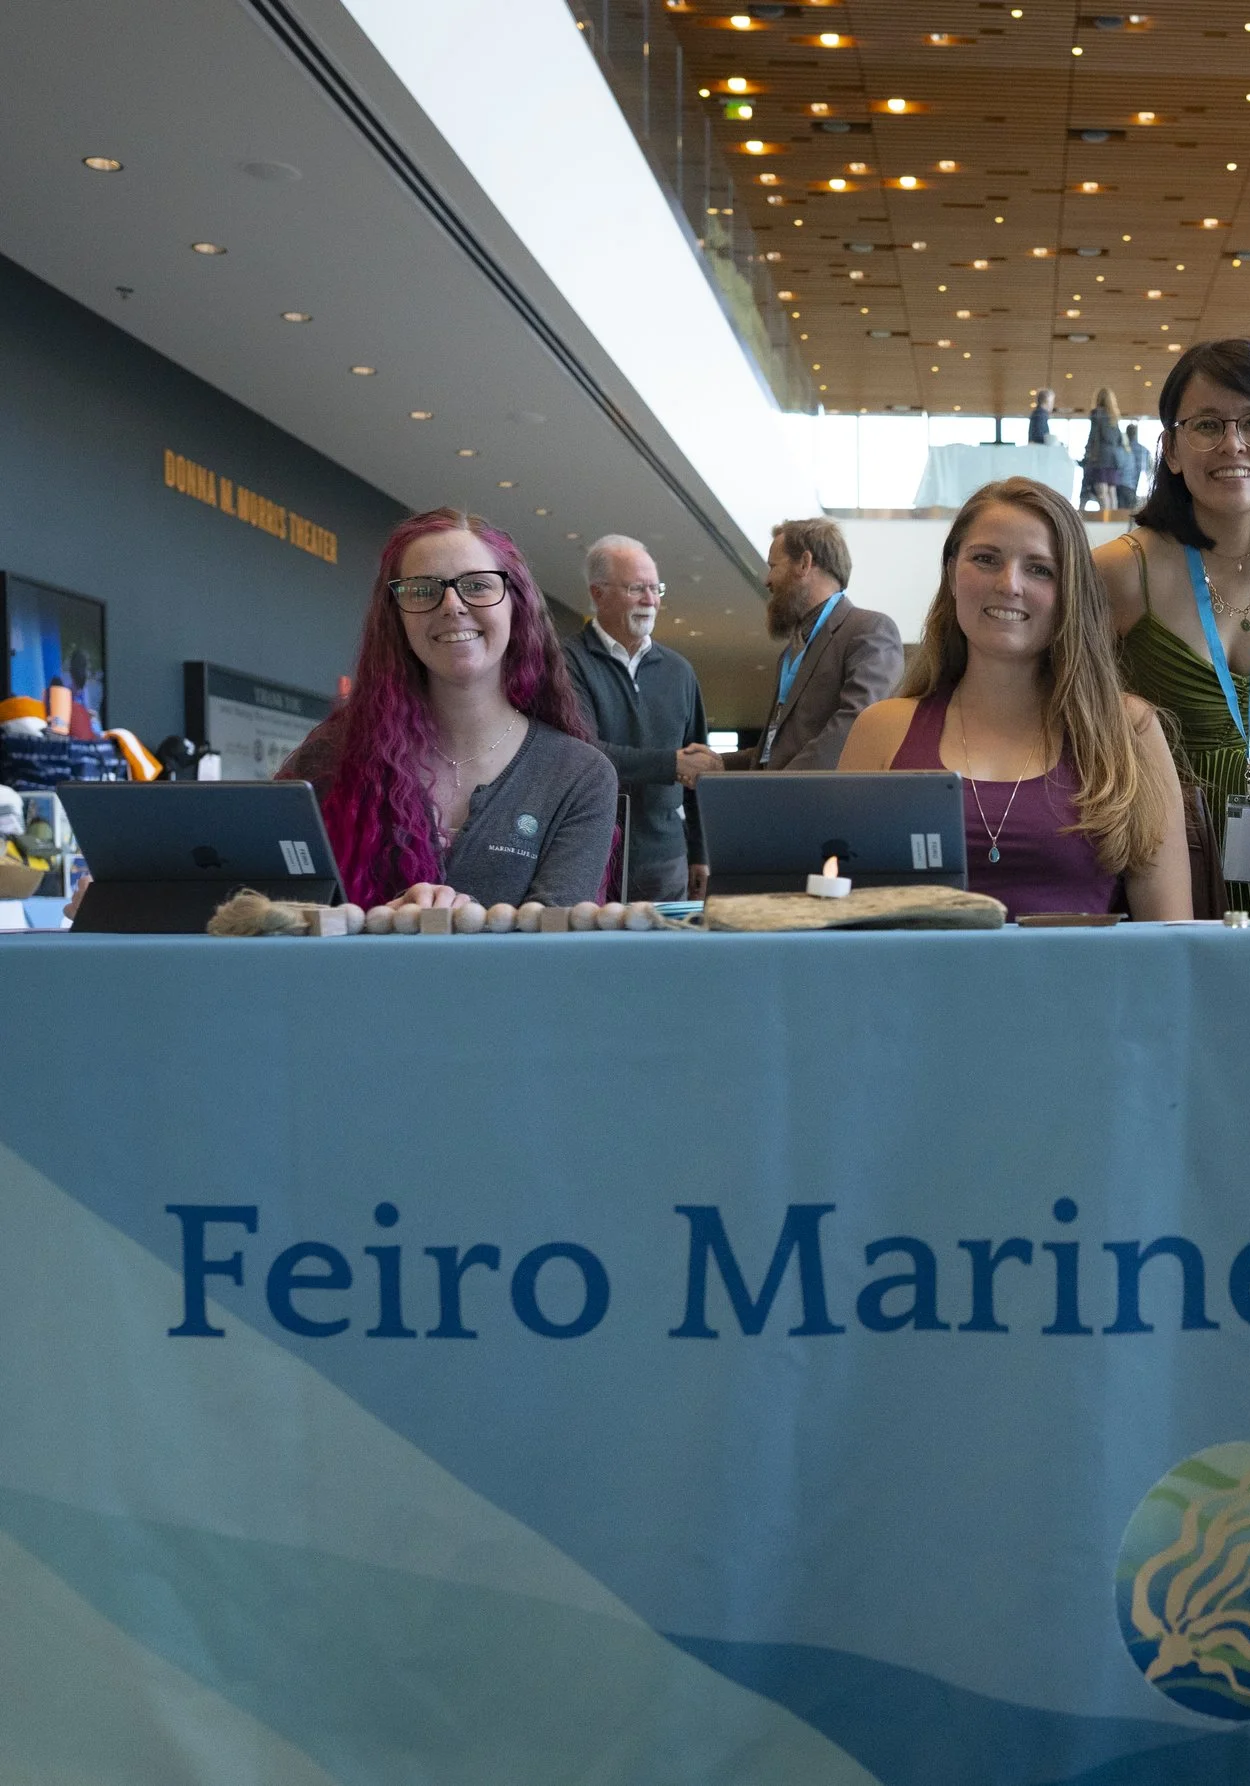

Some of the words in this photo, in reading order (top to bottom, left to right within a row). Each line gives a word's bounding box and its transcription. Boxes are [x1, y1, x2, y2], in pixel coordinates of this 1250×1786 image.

[488, 844, 516, 853] MARINE
[516, 849, 530, 857] LIFE
[165, 1200, 611, 1340] Feiro
